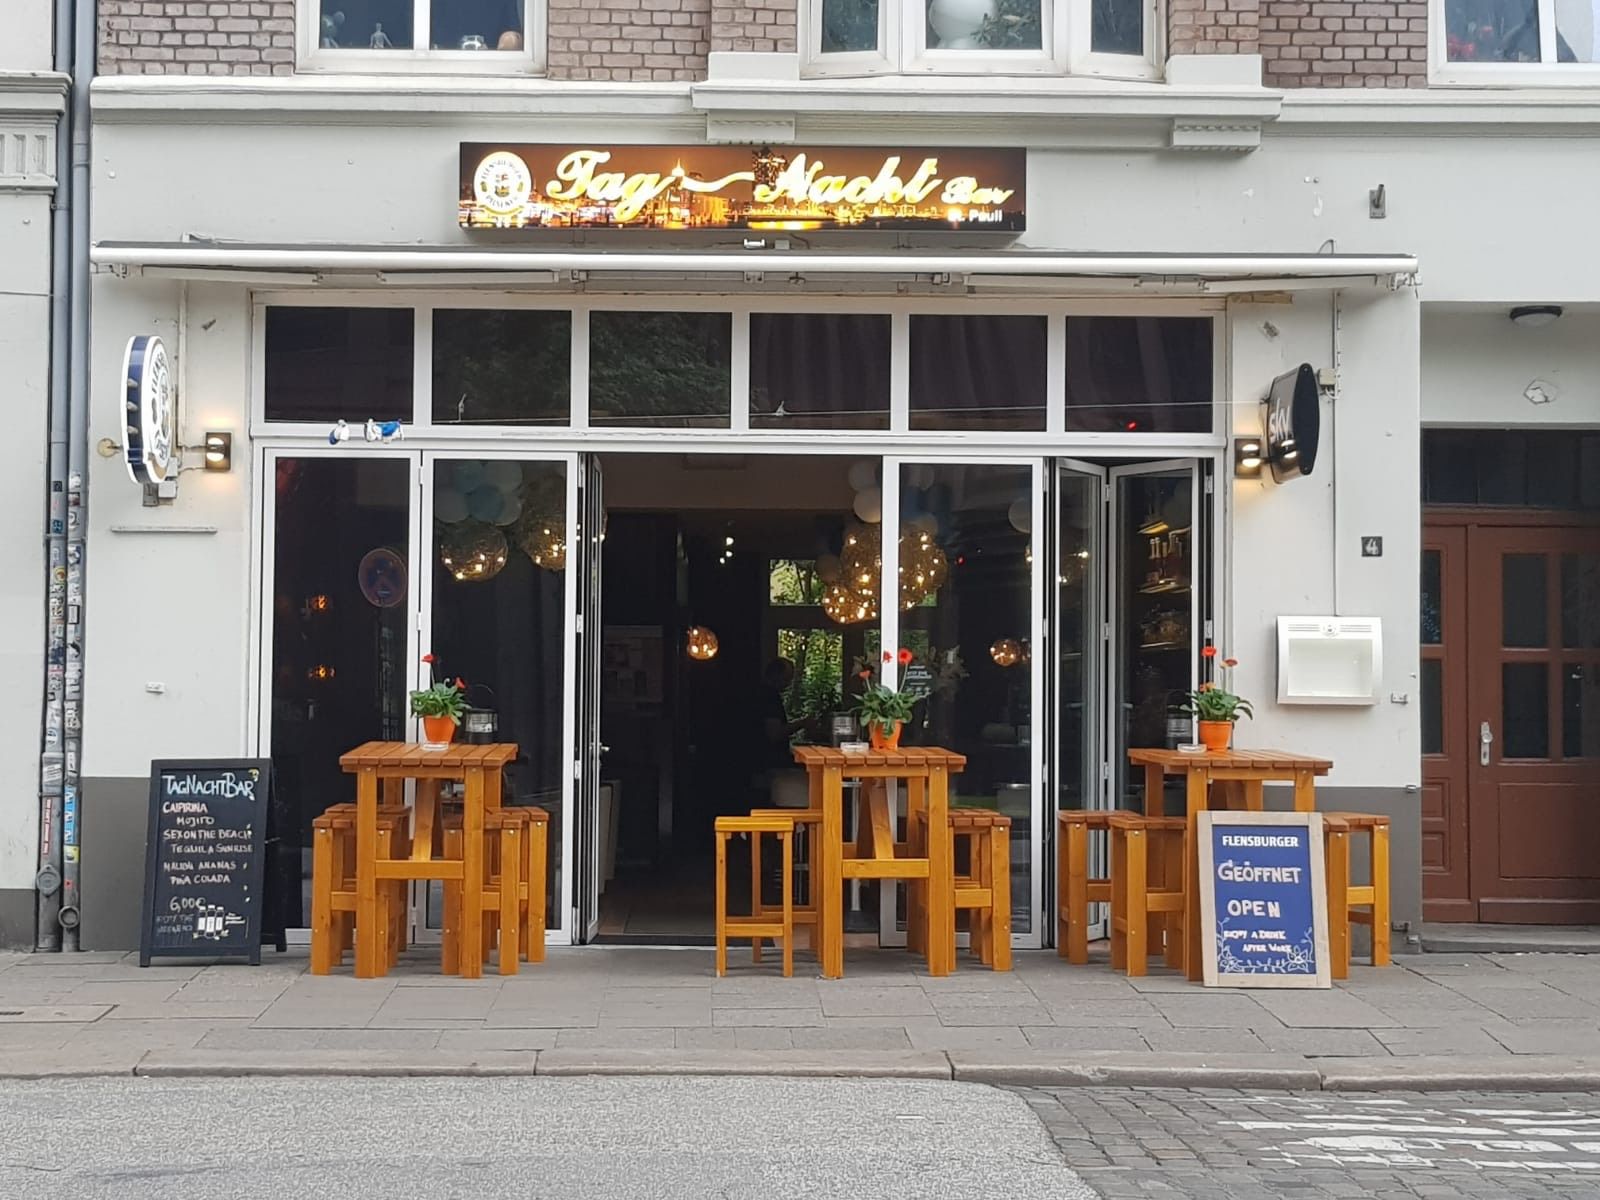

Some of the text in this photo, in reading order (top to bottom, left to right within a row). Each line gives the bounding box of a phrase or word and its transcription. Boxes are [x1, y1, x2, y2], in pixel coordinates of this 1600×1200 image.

[941, 176, 1014, 204] Bar
[1222, 835, 1299, 847] FLENSBURGER
[171, 844, 214, 854] TEQUILA
[199, 861, 237, 870] ANANAS
[1217, 859, 1302, 884] GEÖFFNET
[194, 874, 231, 883] COLADA
[1227, 900, 1281, 918] OPEN
